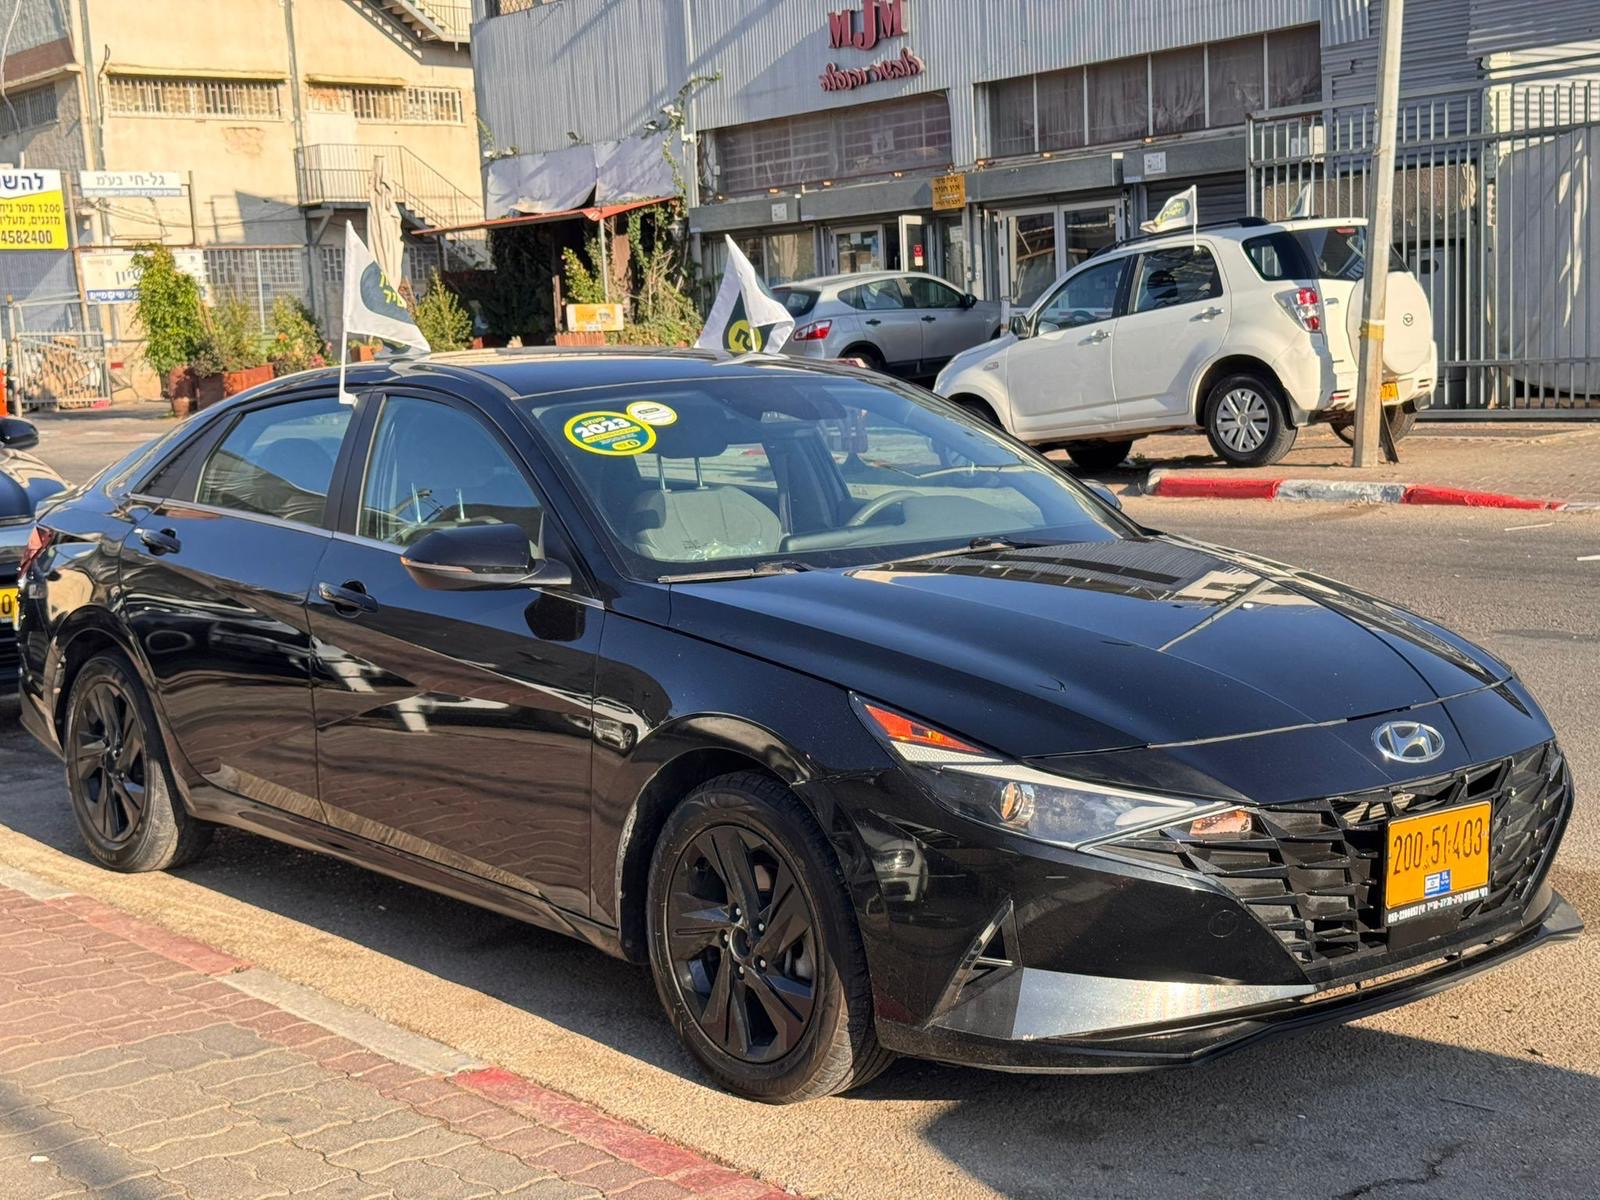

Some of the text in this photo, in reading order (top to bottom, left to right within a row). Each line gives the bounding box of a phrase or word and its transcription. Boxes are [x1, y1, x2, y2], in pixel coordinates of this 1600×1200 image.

[828, 0, 908, 50] MJM
[0, 172, 44, 190] להש
[15, 203, 36, 213] מטר
[38, 203, 61, 213] 1200
[1, 230, 53, 244] 4582400
[574, 417, 631, 438] 2023
